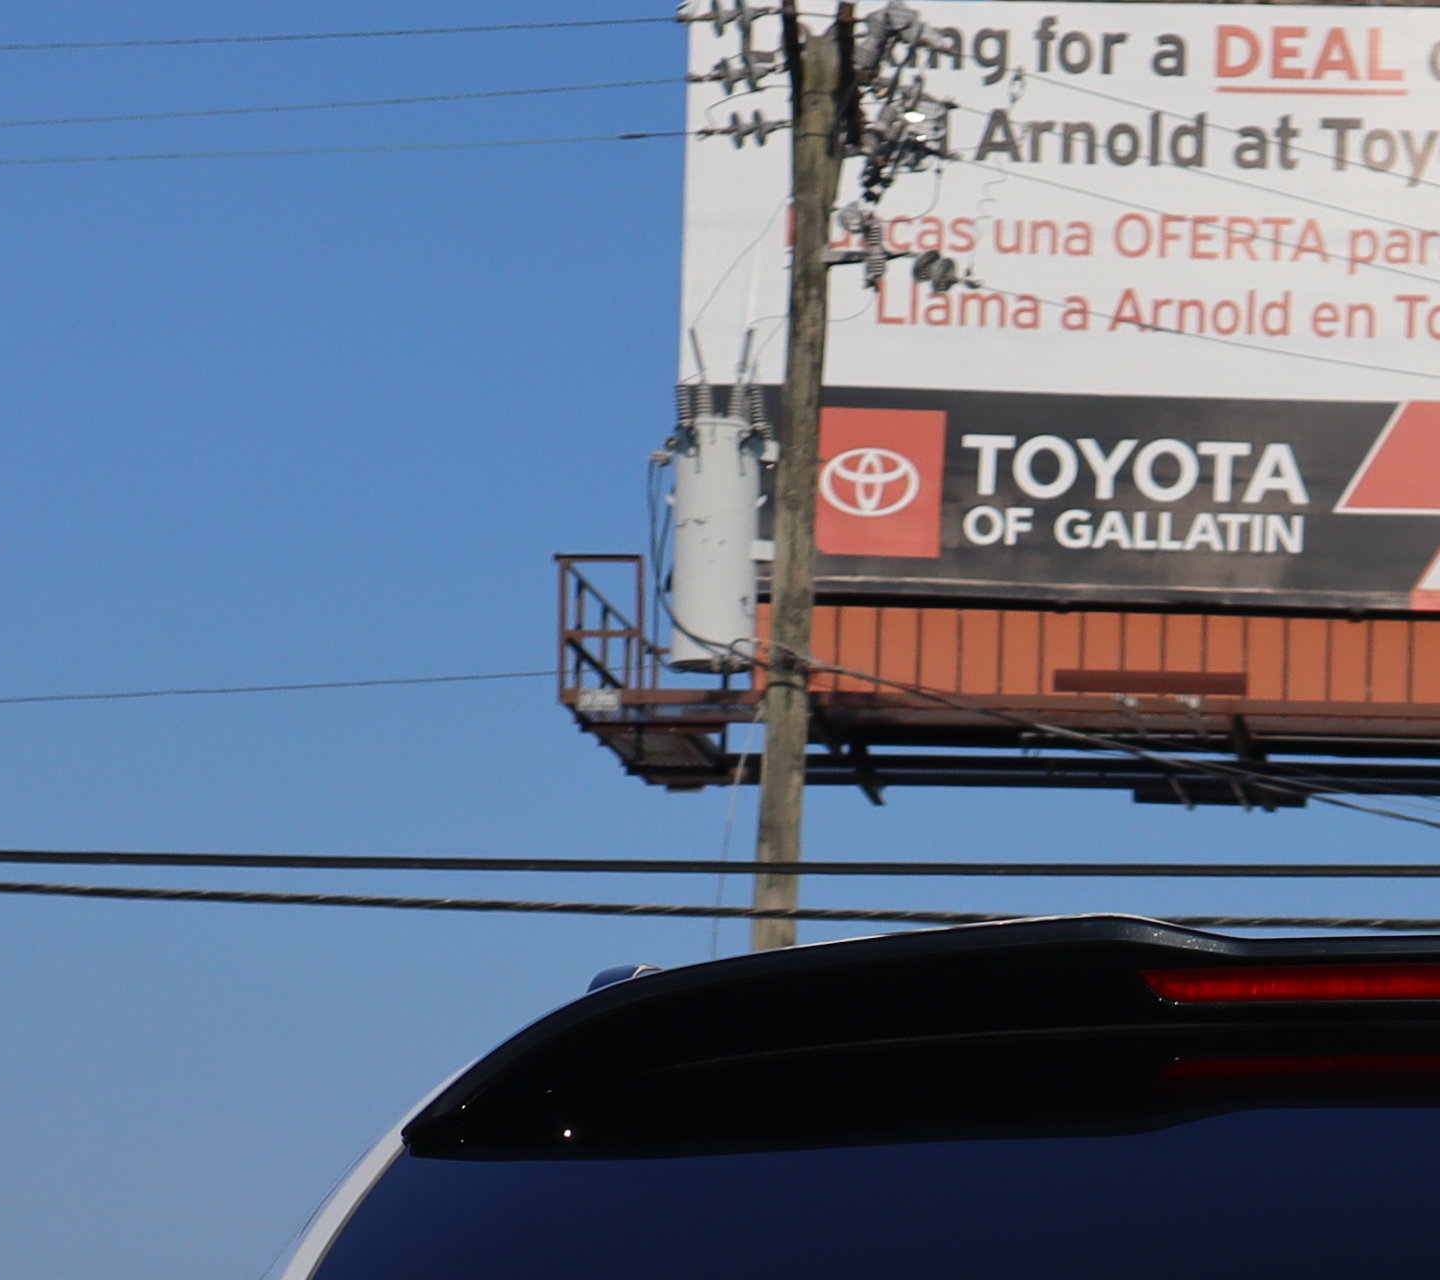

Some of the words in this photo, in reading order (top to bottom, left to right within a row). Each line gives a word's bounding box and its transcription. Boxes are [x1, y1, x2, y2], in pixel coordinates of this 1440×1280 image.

[1035, 16, 1128, 75] for
[1152, 32, 1186, 77] a
[1214, 23, 1406, 83] DEAL
[975, 107, 1207, 167] Arnold
[1232, 113, 1301, 171] at
[994, 217, 1094, 257] una
[1113, 212, 1330, 263] OFERTA
[875, 279, 1042, 330] Llama
[1060, 293, 1091, 331] a
[1107, 286, 1293, 337] Arnold
[1312, 300, 1377, 339] en
[961, 433, 1311, 505] TOYOTA
[962, 505, 1035, 547] OF
[1054, 508, 1305, 554] GALLATIN
